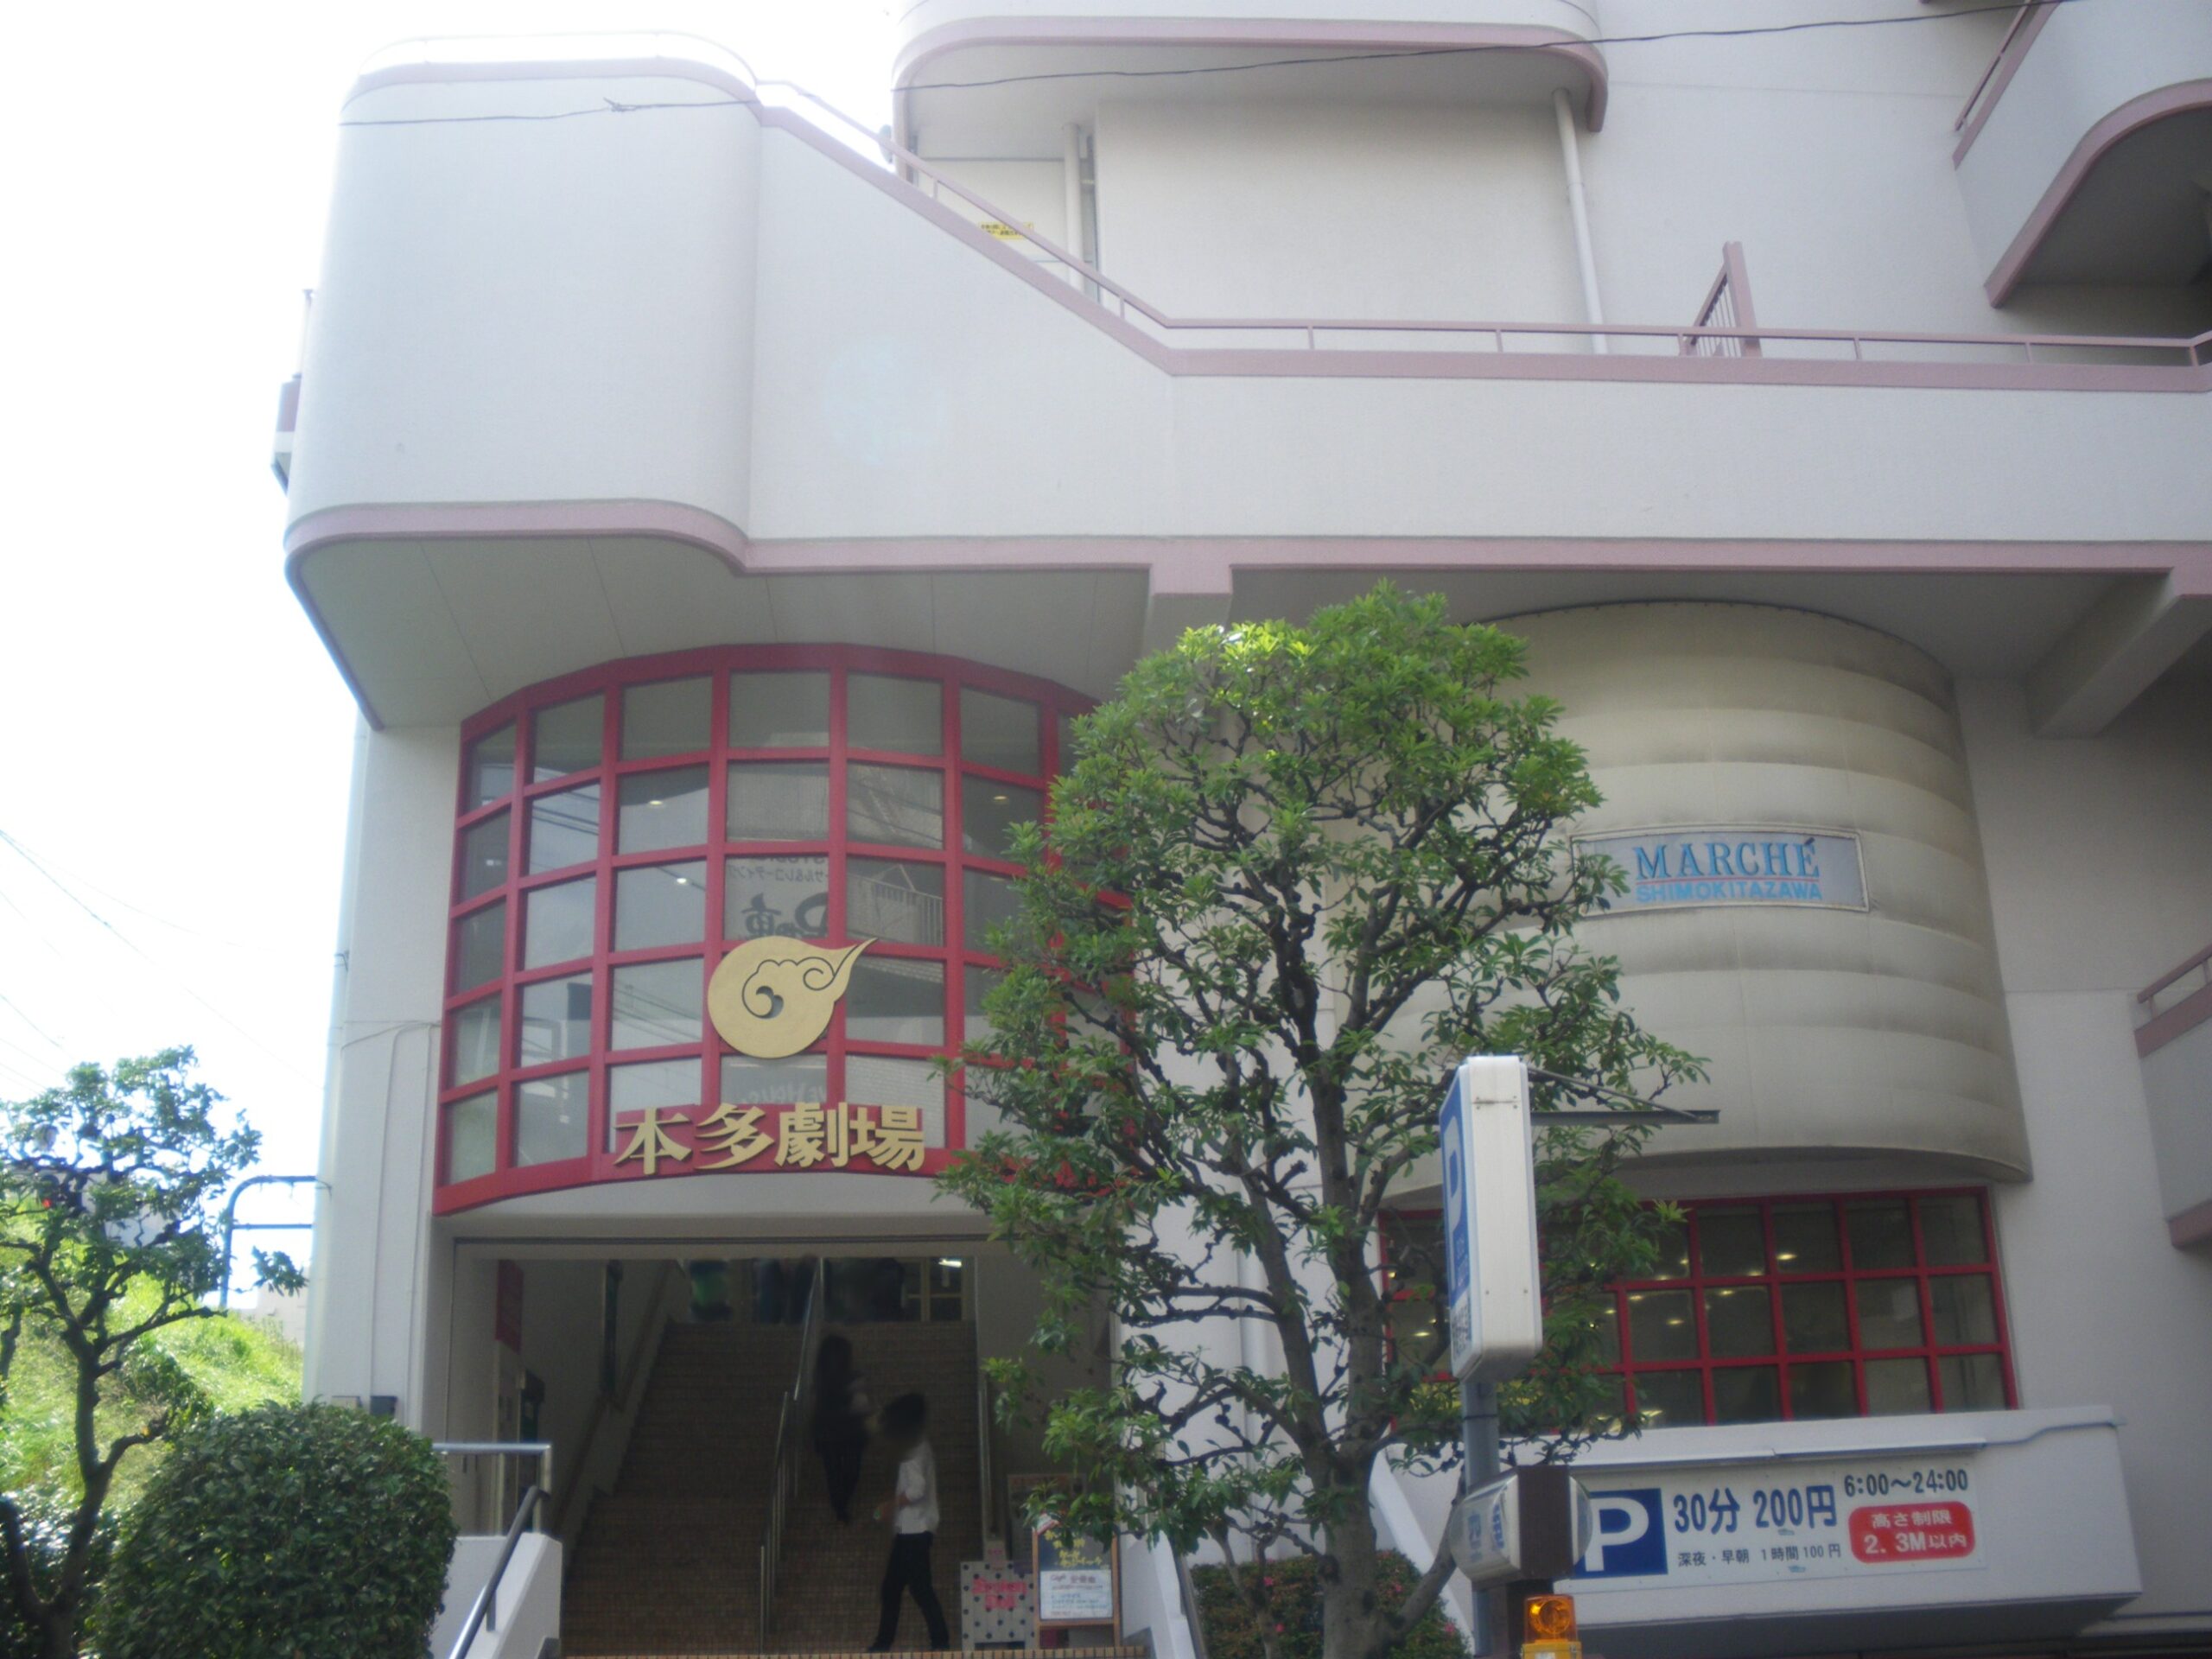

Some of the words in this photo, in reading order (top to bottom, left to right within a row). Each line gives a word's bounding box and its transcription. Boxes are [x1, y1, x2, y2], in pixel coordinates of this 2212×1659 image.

[1632, 837, 1821, 880] MARCHÉ
[1636, 880, 1823, 903] SHIMOKITAZAWA
[613, 1102, 925, 1175] 本多劇場
[1444, 1115, 1463, 1293] P
[1585, 1497, 1649, 1573] P
[1673, 1488, 1740, 1535] 30分
[1753, 1484, 1838, 1529] 200円
[1872, 1509, 1952, 1529] 高さ制限
